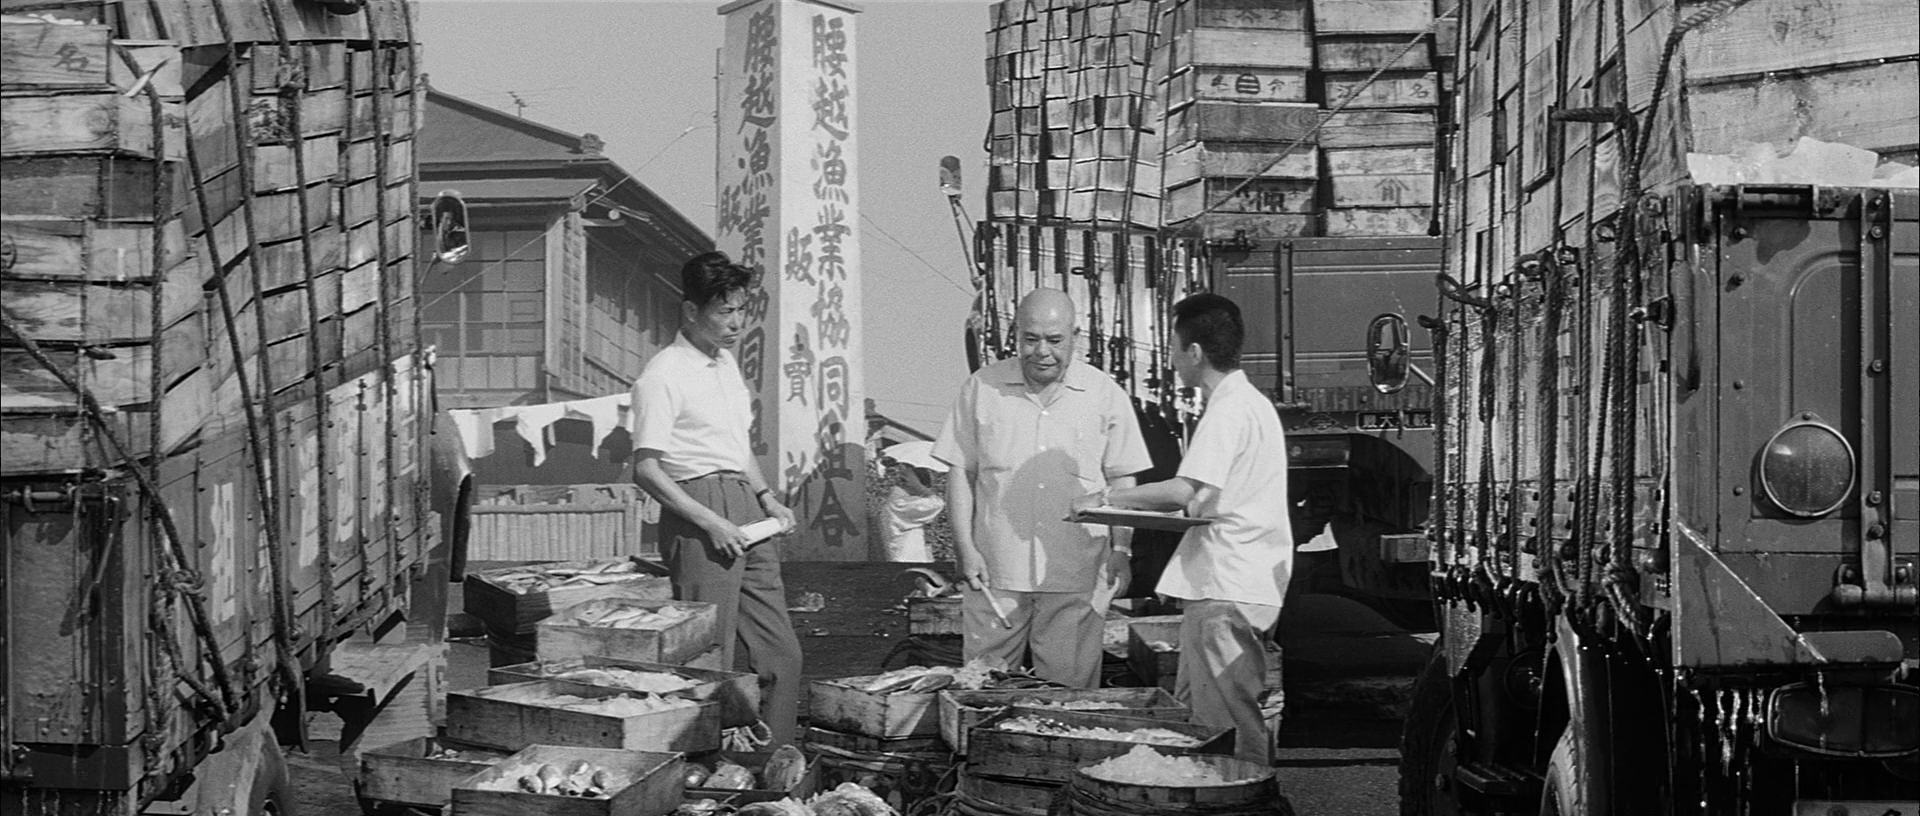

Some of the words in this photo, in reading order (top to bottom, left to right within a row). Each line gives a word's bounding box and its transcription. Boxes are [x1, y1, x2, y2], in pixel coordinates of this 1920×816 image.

[810, 14, 860, 547] 腰越漁業協同組合
